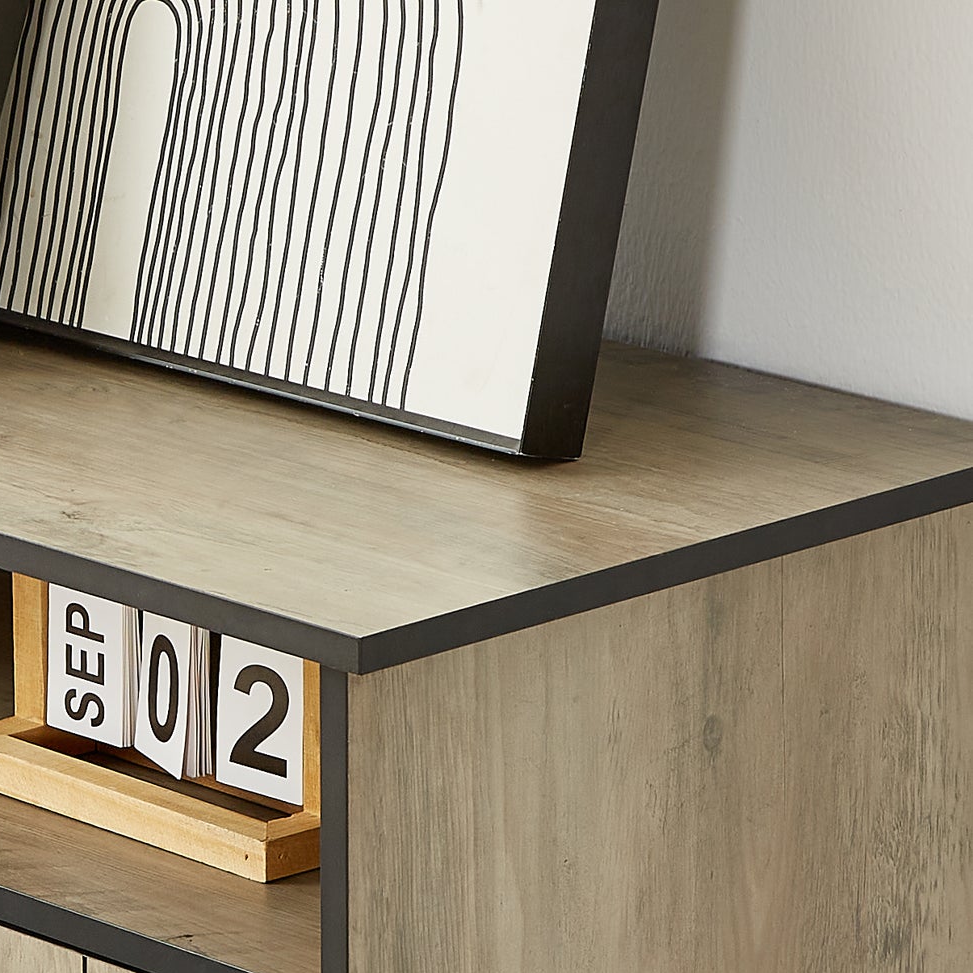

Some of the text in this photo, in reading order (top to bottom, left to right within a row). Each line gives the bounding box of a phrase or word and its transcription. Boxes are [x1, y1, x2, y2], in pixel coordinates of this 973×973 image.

[64, 602, 105, 728] SEP
[147, 633, 290, 779] 0 2
